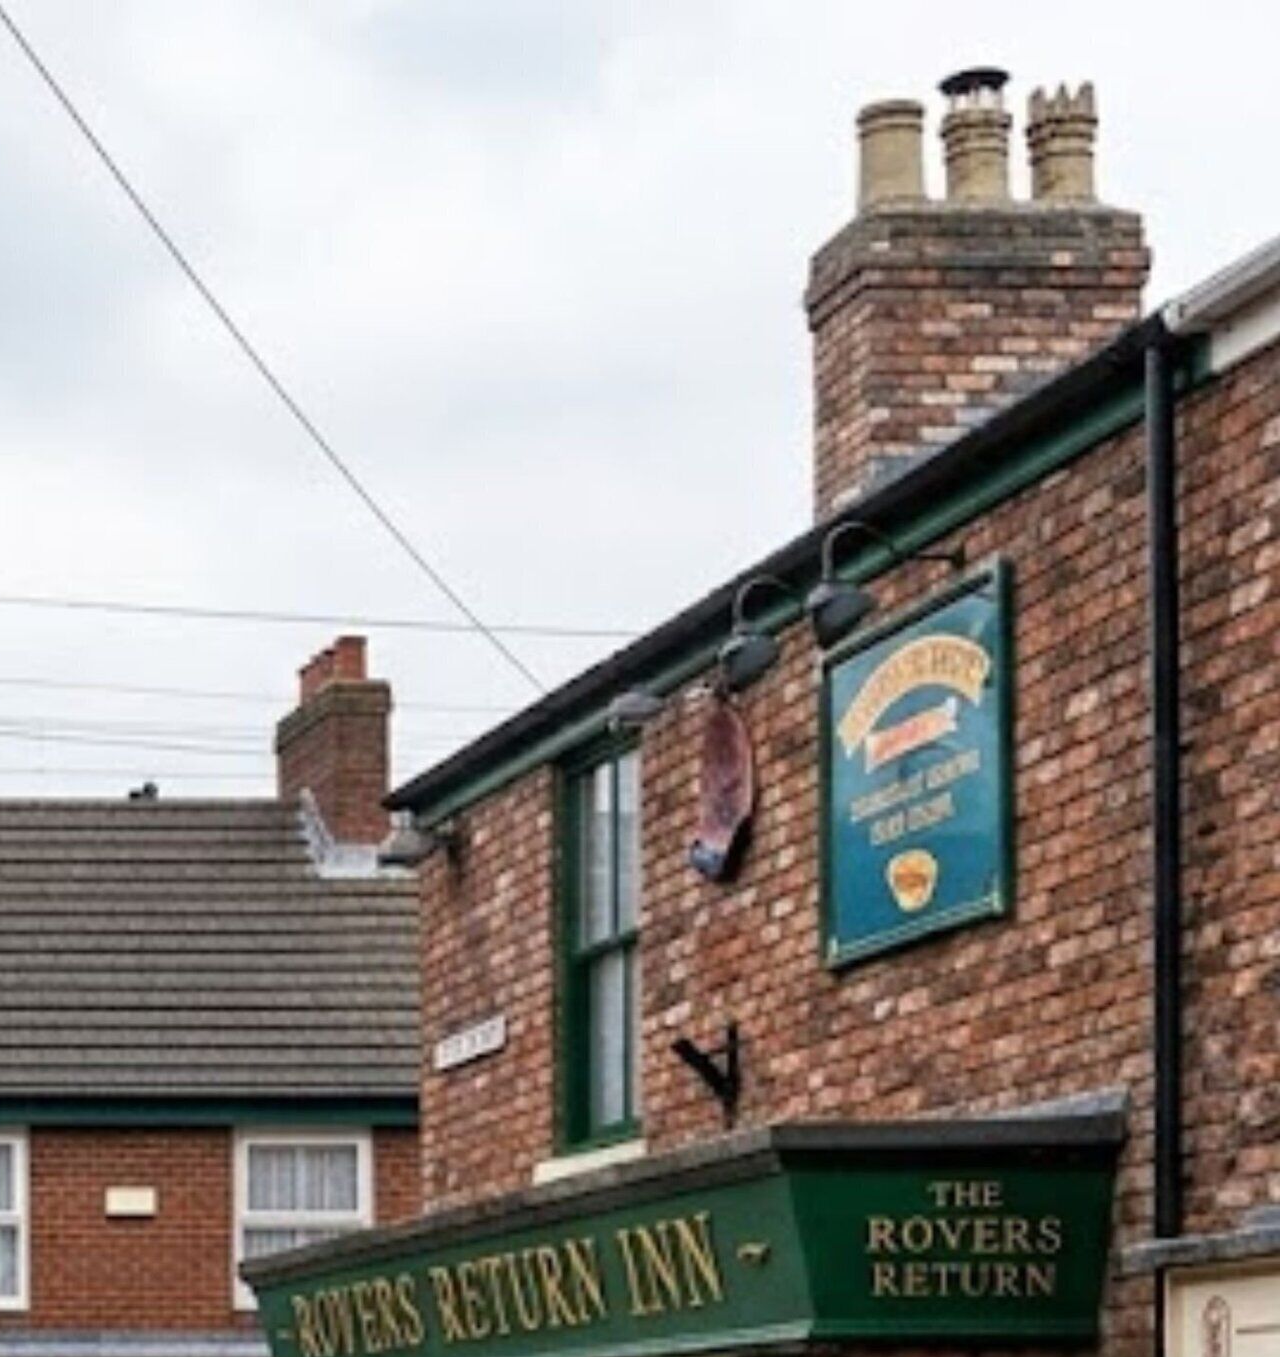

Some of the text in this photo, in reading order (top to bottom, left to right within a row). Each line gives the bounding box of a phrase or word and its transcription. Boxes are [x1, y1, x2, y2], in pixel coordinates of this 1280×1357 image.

[927, 1179, 1004, 1208] THE
[866, 1214, 1064, 1254] ROVERS
[429, 1237, 607, 1343] RETURN
[616, 1210, 725, 1318] INN
[871, 1261, 1057, 1298] RETURN
